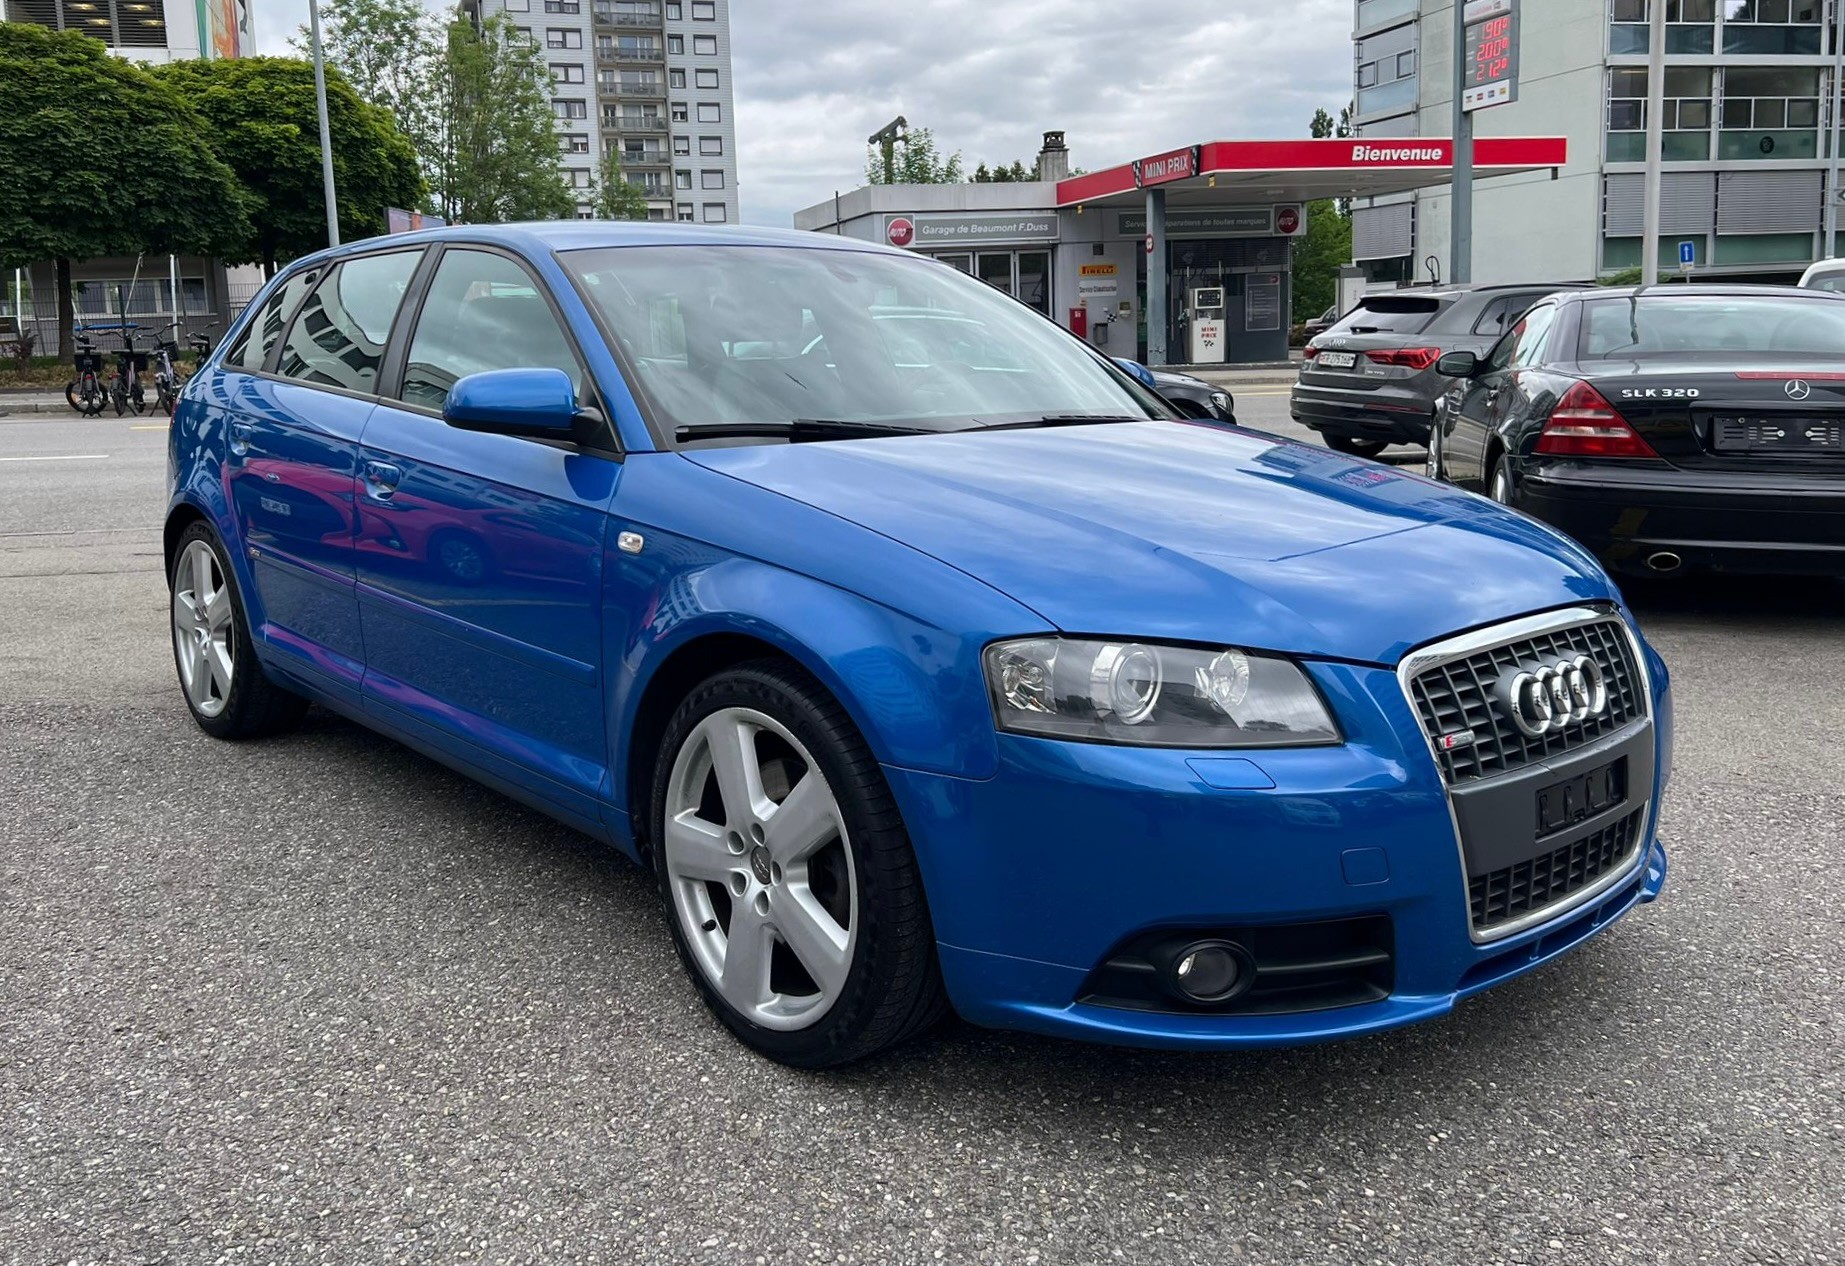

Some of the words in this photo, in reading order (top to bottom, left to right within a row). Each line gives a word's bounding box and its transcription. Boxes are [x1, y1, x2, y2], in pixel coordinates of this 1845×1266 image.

[1351, 145, 1443, 161] Bienvenue
[1144, 160, 1166, 179] MINI
[1167, 154, 1189, 174] PRIX
[1202, 218, 1212, 226] de
[1213, 218, 1235, 226] toutes
[1236, 217, 1267, 227] marques
[922, 225, 955, 236] Garage
[957, 224, 969, 234] de
[970, 223, 1017, 234] Beaumont
[1018, 222, 1049, 232] F.Duss
[1081, 265, 1114, 275] PIRELLI
[1621, 389, 1657, 398] SLK
[1661, 388, 1700, 398] 320
